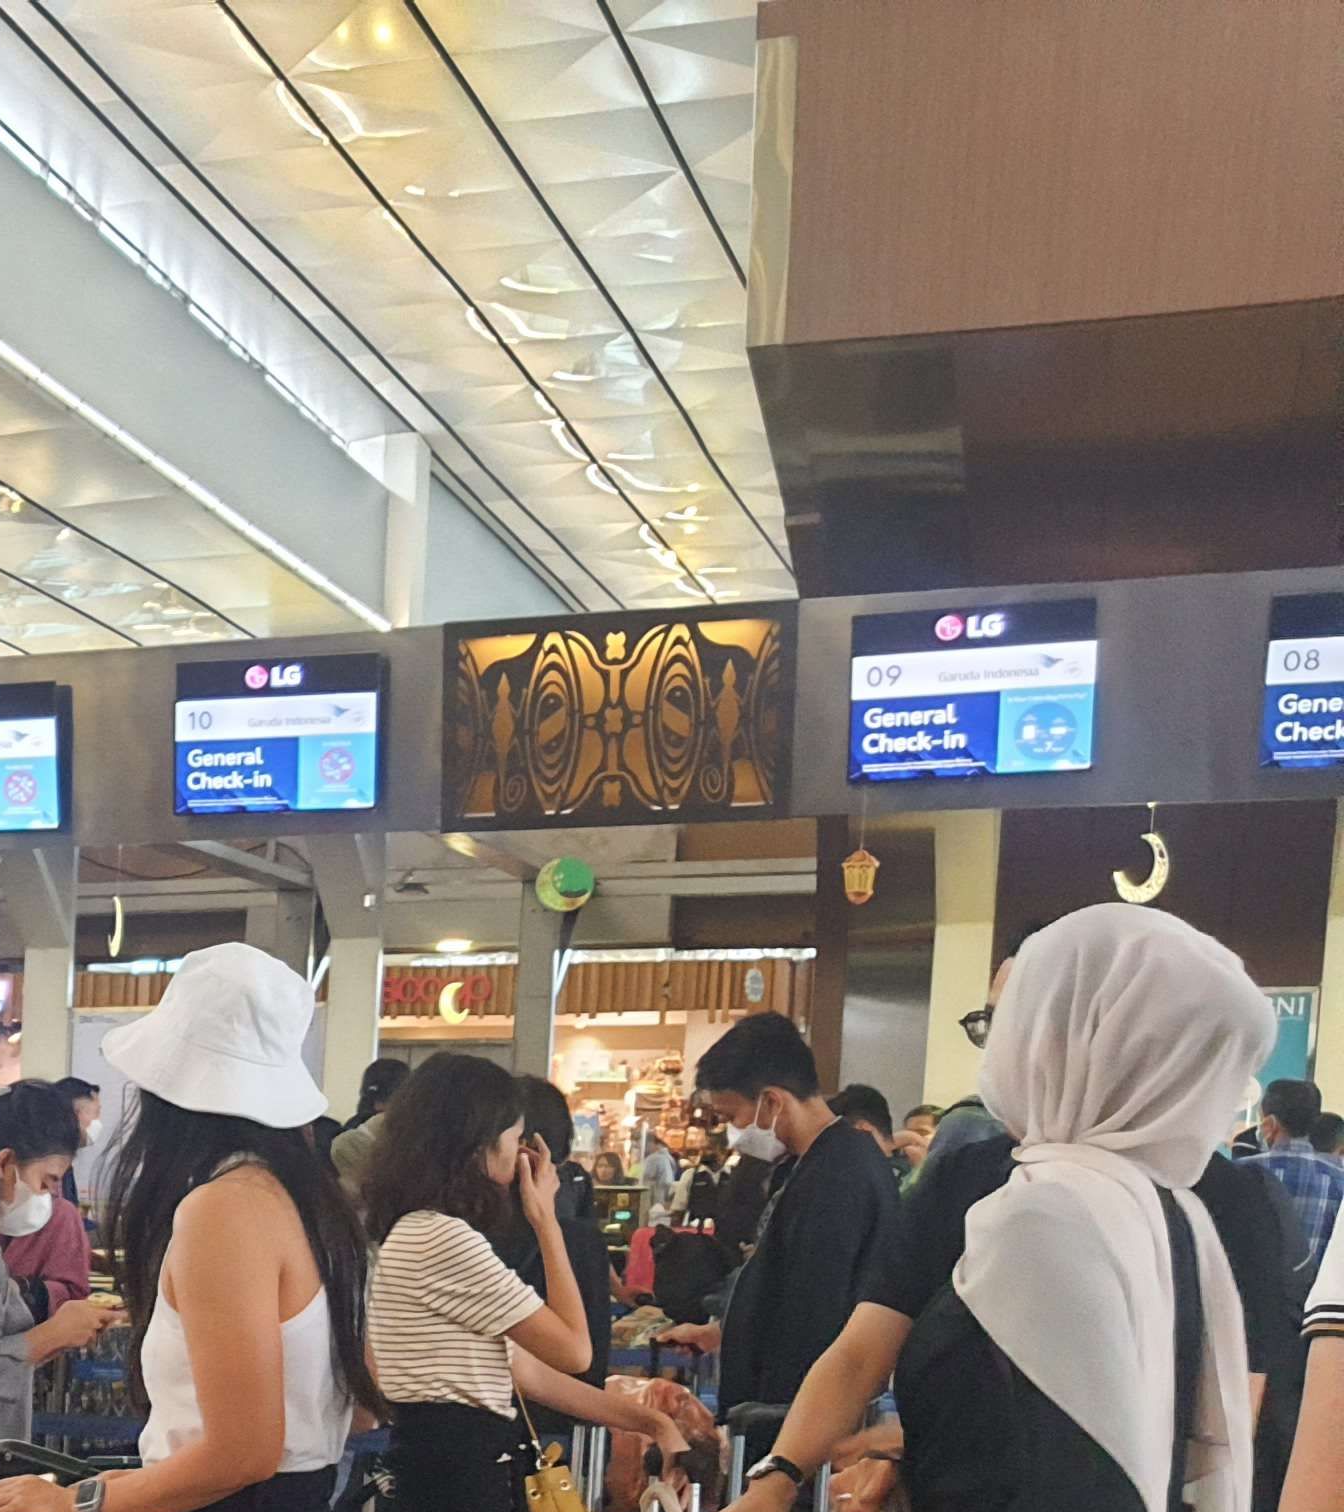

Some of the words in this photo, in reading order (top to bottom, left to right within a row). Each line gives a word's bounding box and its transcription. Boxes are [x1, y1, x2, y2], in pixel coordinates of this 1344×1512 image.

[966, 613, 1005, 639] LG
[1283, 649, 1320, 672] 08
[270, 664, 303, 688] LG
[866, 665, 902, 687] 09
[938, 670, 980, 683] Garuda
[983, 667, 1039, 680] Indonesia
[1277, 693, 1344, 715] Gene
[187, 711, 212, 730] 10
[863, 703, 957, 729] General
[862, 730, 967, 754] Check-in
[186, 747, 265, 768] General
[186, 770, 272, 790] Check-in
[1271, 996, 1305, 1016] NI
